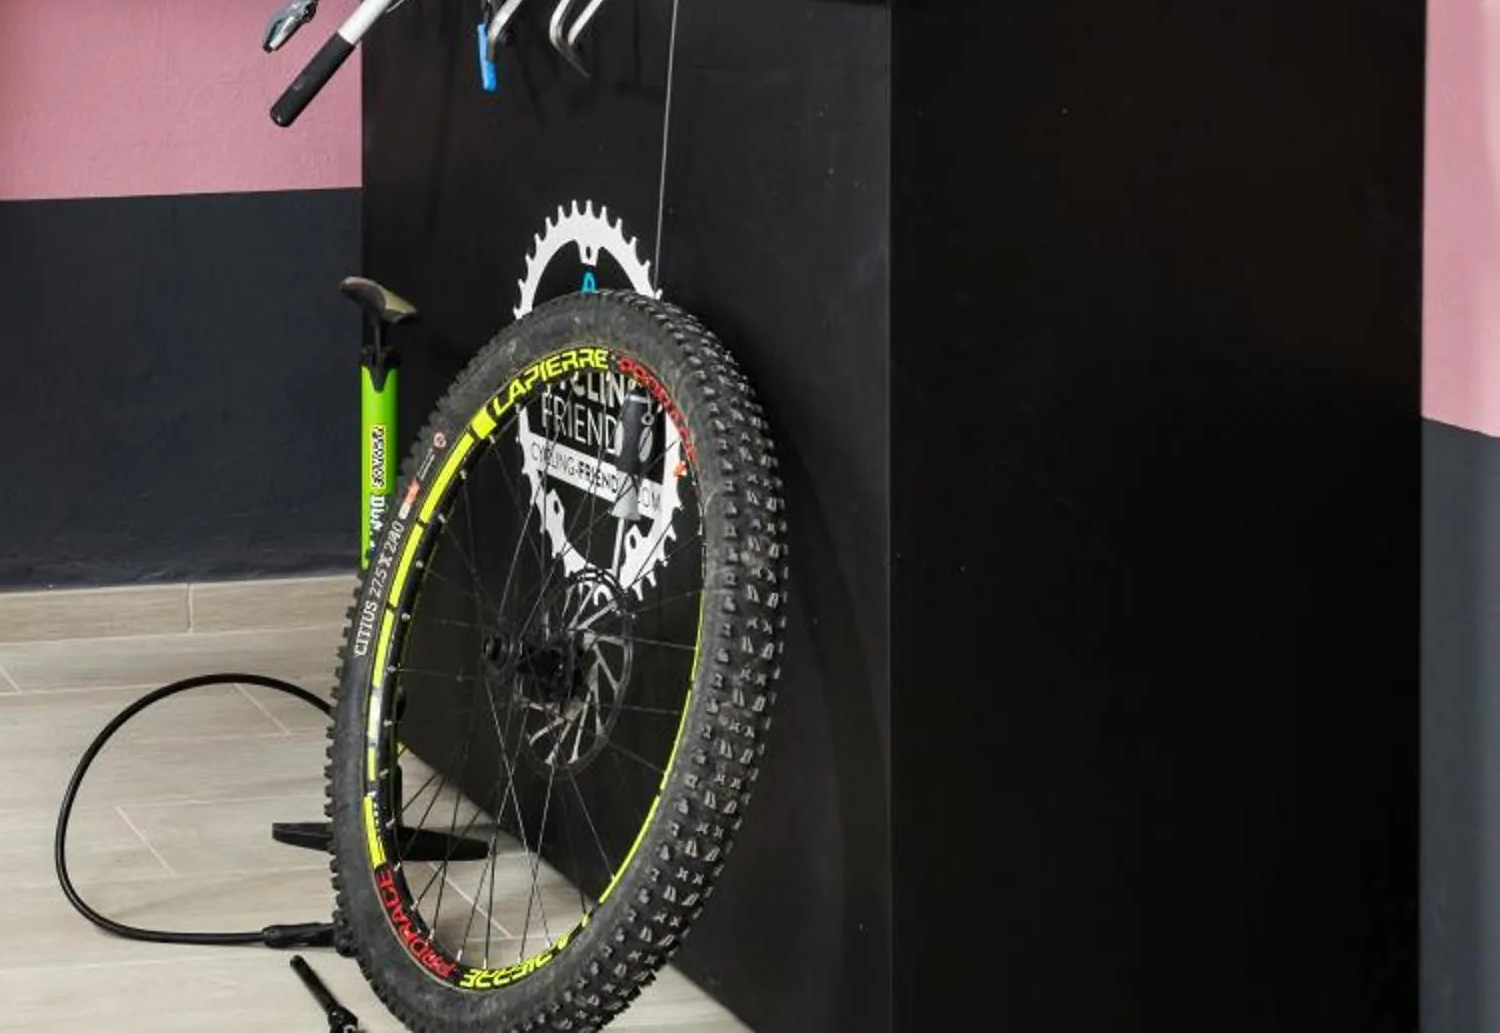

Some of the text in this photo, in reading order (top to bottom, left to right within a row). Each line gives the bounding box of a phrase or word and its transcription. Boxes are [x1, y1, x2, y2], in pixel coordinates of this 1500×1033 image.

[493, 349, 608, 415] LAPIERRE
[541, 392, 619, 455] FRIEND
[355, 600, 377, 658] CITIUS
